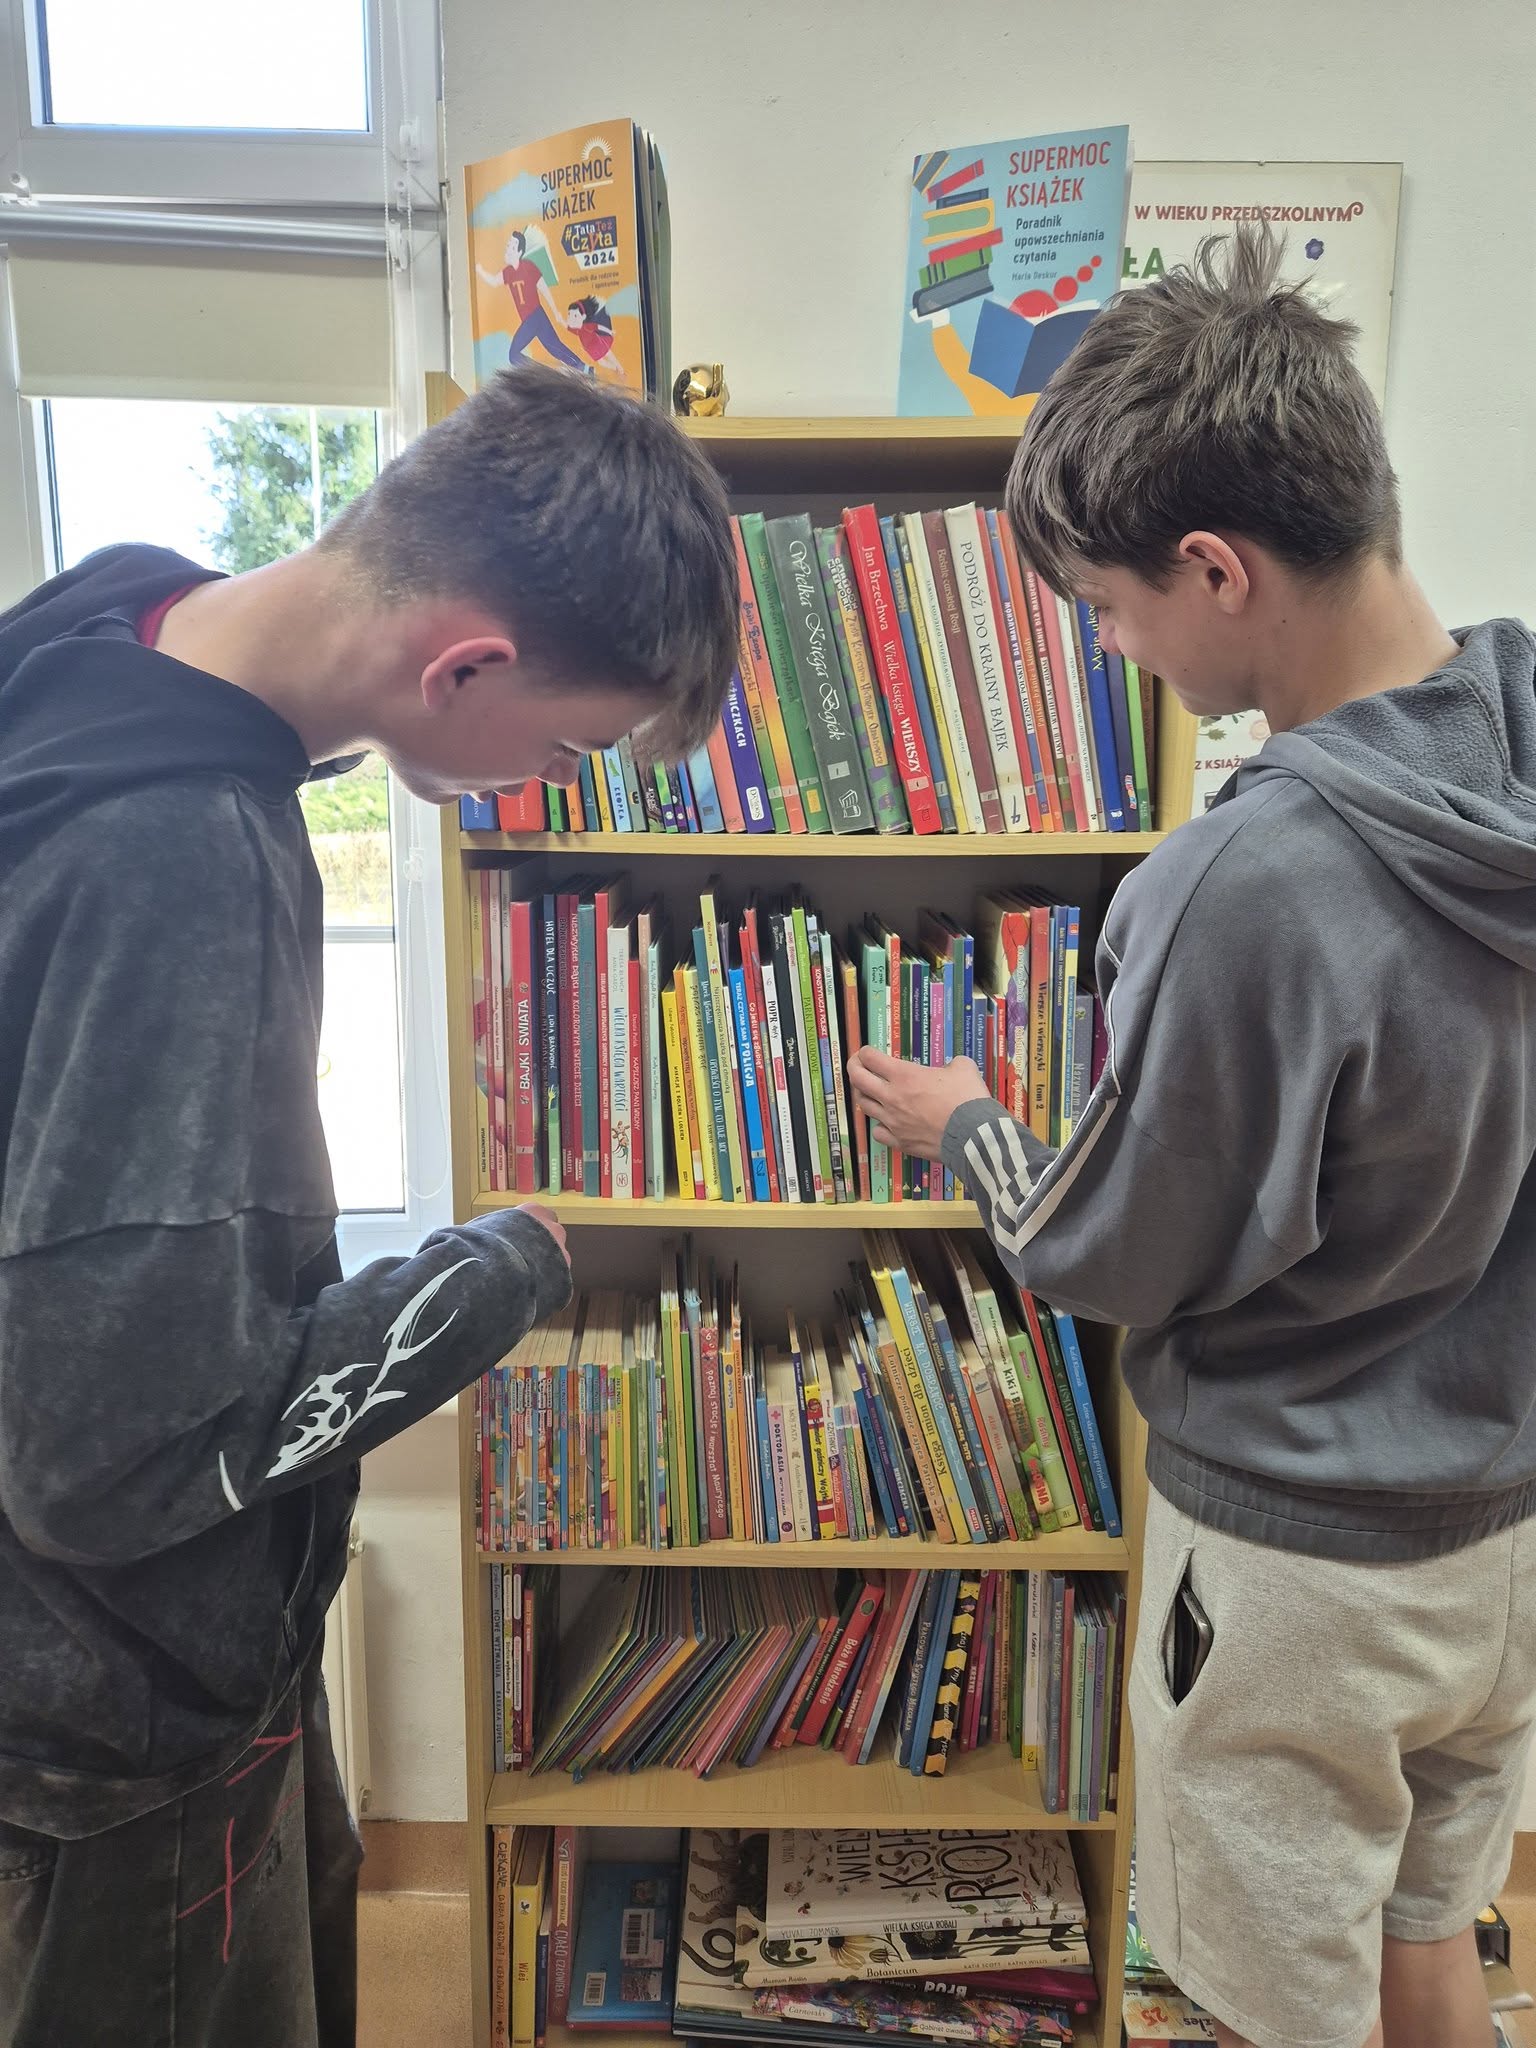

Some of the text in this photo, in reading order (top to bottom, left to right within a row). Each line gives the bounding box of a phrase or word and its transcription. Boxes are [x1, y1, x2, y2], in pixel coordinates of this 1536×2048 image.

[541, 157, 613, 193] SUPERMOC
[1009, 141, 1112, 175] SUPERMOC
[542, 187, 596, 222] KSIĄŻEK
[1006, 176, 1085, 208] KSIĄŻEK
[1016, 214, 1062, 230] Poradnik
[1134, 201, 1364, 222] W WIEKU PRZEDSZKOLNYM
[570, 232, 614, 252] Czyta
[1014, 229, 1105, 249] upowszechniania
[584, 251, 616, 267] 2024
[1013, 249, 1057, 265] czytania
[827, 559, 851, 613] NETWORK
[834, 557, 859, 611] CARTOON
[788, 540, 842, 743] Wielka Księga Bajek
[1004, 601, 1020, 656] DLA MALUCHÓW
[862, 545, 922, 774] Jan Brzechwa Wielka księga WIERSZY
[959, 540, 1008, 753] PODRÓŻ DO KRAINY BAJEK
[751, 704, 762, 725] tom
[1194, 760, 1202, 770] Z
[614, 786, 625, 821] KROPKA
[545, 920, 555, 946] HOTEL
[545, 948, 555, 963] DLA
[545, 965, 555, 996] UCZUĆ
[713, 986, 725, 1033] Najszczęśliwsza
[737, 1001, 745, 1025] CZYTAM
[749, 1002, 757, 1012] Co
[768, 1000, 778, 1023] POPR
[814, 968, 827, 1037] KONSTYTUCJA POLSKI
[1037, 981, 1048, 1020] Wiersze
[515, 999, 530, 1090] BAJKI ŚWIATA
[739, 1025, 747, 1041] SAM
[803, 996, 818, 1074] PARKI NARODOWE
[1033, 1025, 1047, 1071] wierszyki
[572, 1000, 582, 1107] KOLOROWYM ŚWIECIE DZIECI
[613, 1006, 629, 1112] WIELKA KSIĘGA WARTOŚCI
[741, 1042, 755, 1088] POLICJA
[1035, 1082, 1046, 1102] tom
[1072, 1062, 1085, 1107] Nazywam
[904, 1301, 945, 1411] WIERSZE NA DOBRANOC
[887, 1353, 938, 1497] Lotnicze podróże zająca Patryka
[901, 1347, 947, 1476] Księga imion dla dzieci
[705, 1369, 726, 1519] Poznaj stację warsztat Maurycego
[775, 1423, 786, 1473] DOKTOR ASIA
[790, 1424, 798, 1443] TATA
[812, 1447, 825, 1477] gaśniczy
[829, 1456, 839, 1468] dla
[830, 1469, 842, 1503] malucha
[819, 1637, 859, 1705] Boże Narodzenie
[780, 1925, 840, 1940] YUVAL ZOMMER
[882, 1918, 959, 1933] WIELKA KSIĘGA ROBALI
[517, 1961, 529, 1982] Wieś
[554, 1929, 568, 1998] CIAŁO CZŁOWIEKA
[866, 1965, 919, 1978] Botanicum
[923, 1980, 967, 1999] Brud
[945, 2024, 973, 2037] owadów
